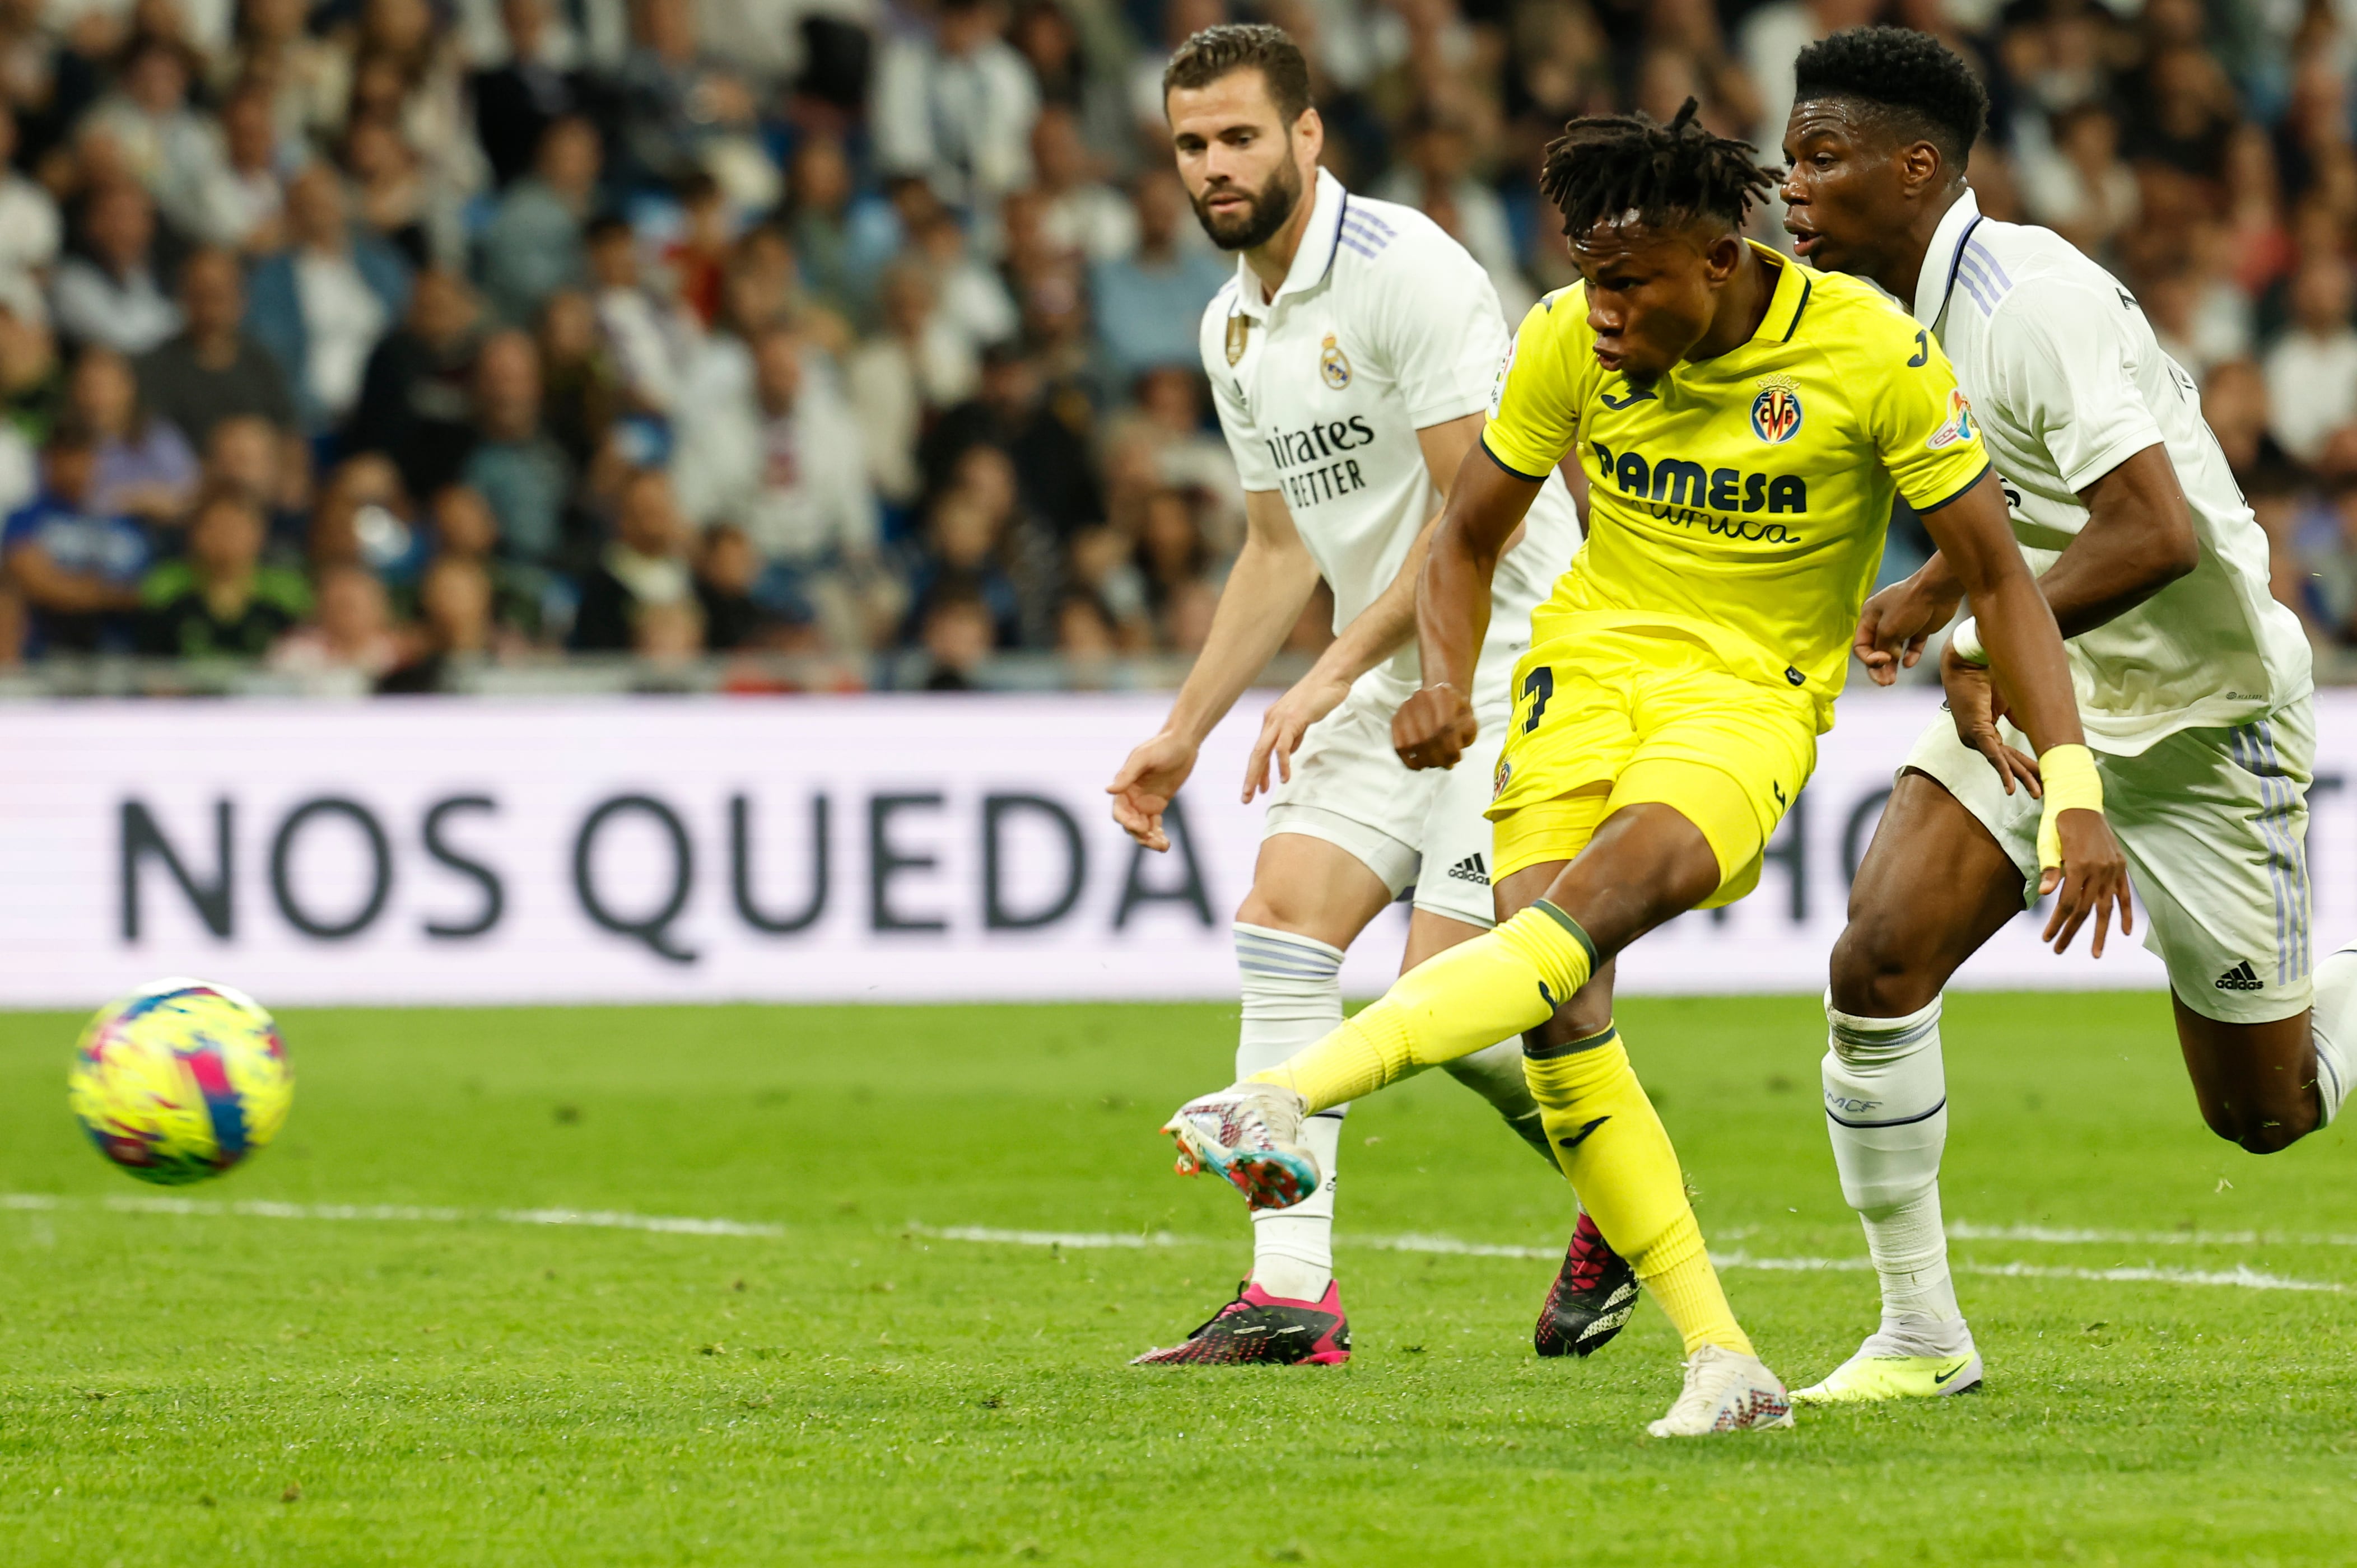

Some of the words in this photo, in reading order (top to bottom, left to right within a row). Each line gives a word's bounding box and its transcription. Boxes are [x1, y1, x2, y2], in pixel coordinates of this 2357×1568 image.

[1591, 441, 1808, 514] PAMESA
[120, 793, 506, 943] NOS
[572, 791, 1216, 963] QUEDA
[2215, 979, 2264, 990] adidas
